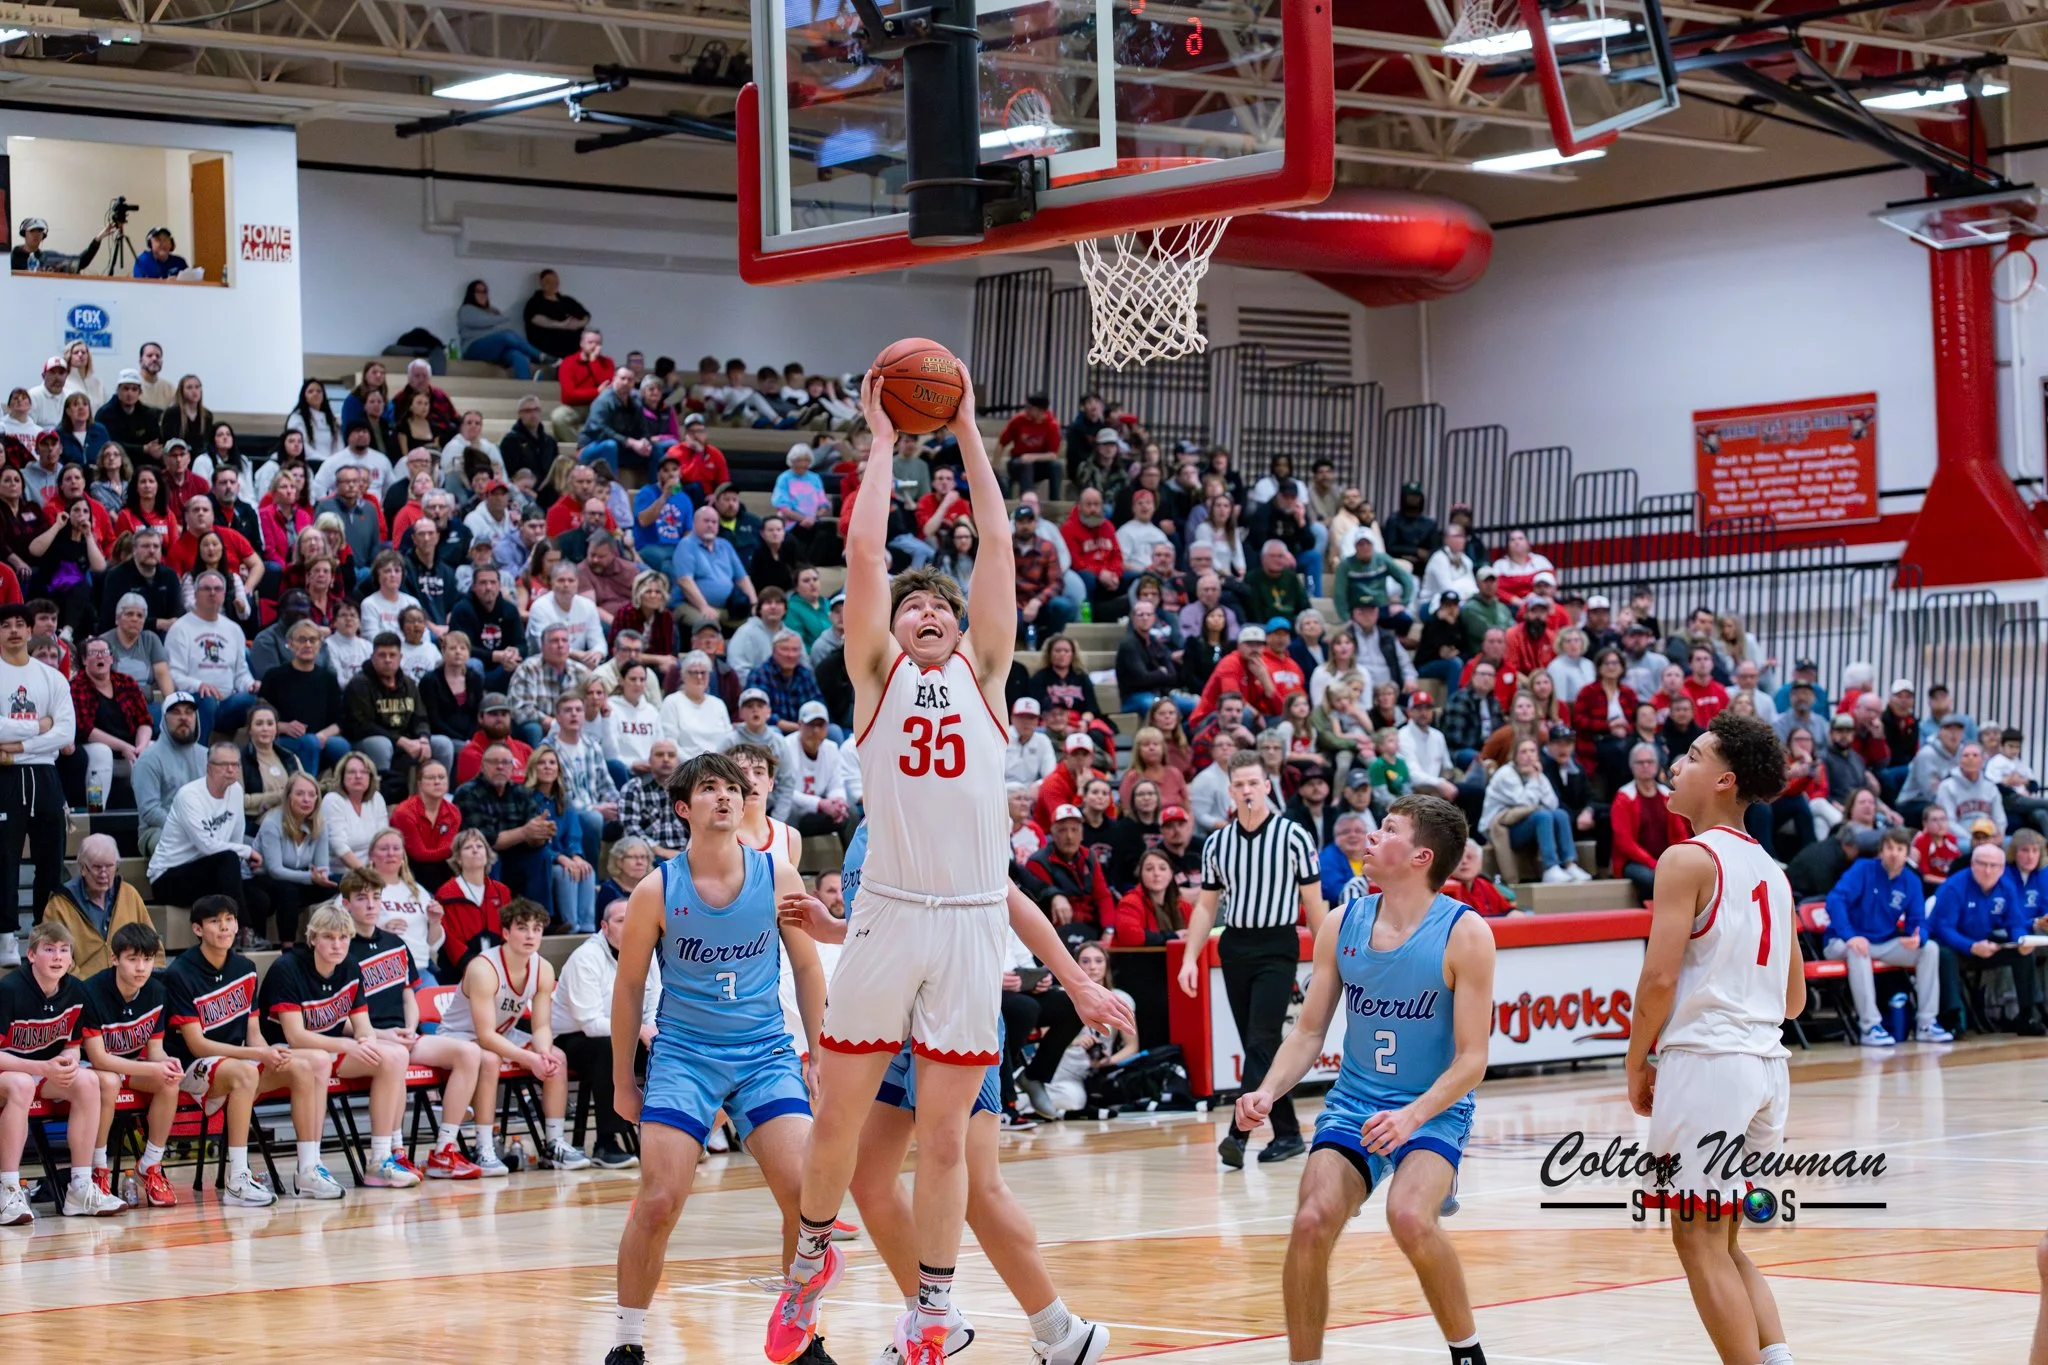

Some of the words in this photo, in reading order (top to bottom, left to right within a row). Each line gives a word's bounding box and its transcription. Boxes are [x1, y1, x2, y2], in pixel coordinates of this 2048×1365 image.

[240, 224, 291, 244] HOME
[242, 242, 292, 263] Adults
[75, 309, 101, 324] FOX
[914, 684, 951, 709] EAS
[621, 721, 654, 736] EAST
[899, 714, 967, 779] 35
[382, 900, 425, 914] EAST
[1751, 879, 1772, 967] 1
[676, 929, 772, 964] Merrill
[361, 961, 389, 990] AUSAU
[715, 971, 738, 1001] 3
[226, 984, 249, 1014] EAST
[1343, 981, 1440, 1021] Merrill
[12, 1026, 51, 1048] WAUSAU
[1374, 1029, 1397, 1075] 2
